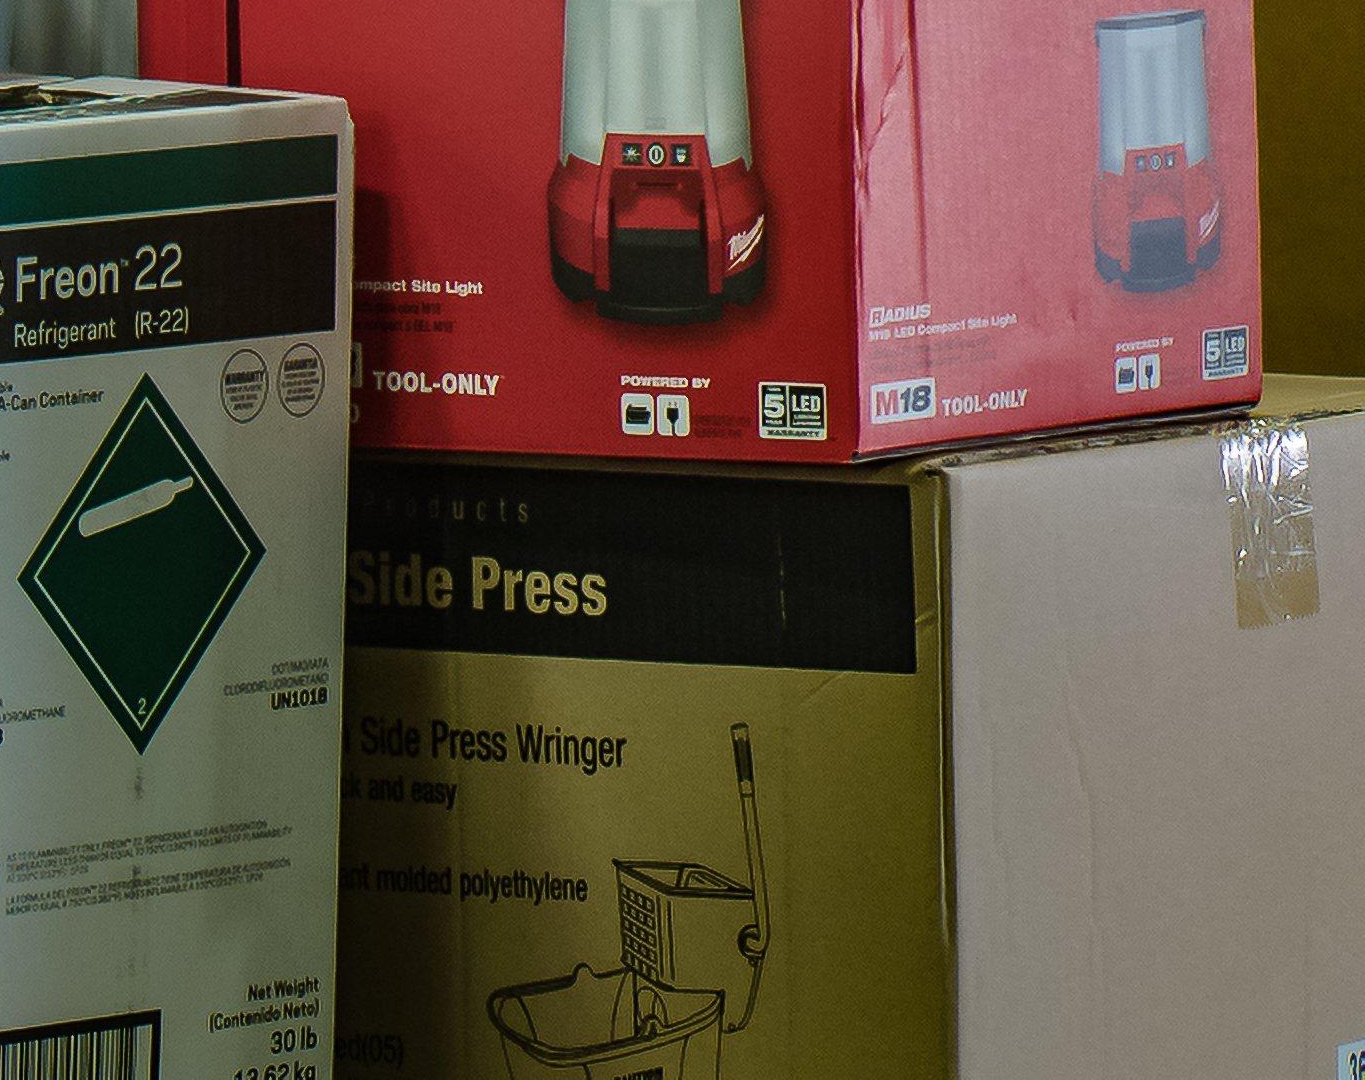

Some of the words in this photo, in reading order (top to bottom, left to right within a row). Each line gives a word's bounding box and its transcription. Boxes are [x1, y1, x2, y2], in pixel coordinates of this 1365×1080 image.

[13, 317, 117, 349] Refrigerant
[135, 307, 189, 338] (R-22)
[373, 371, 500, 396] TOOL-ONLY
[621, 375, 689, 389] POWERED
[691, 376, 711, 389] BY
[38, 388, 105, 410] Container
[764, 391, 785, 418] 5
[792, 394, 821, 413] LED
[875, 384, 932, 416] M18
[941, 388, 1028, 417] TOOL-ONLY
[349, 549, 453, 610] Side
[471, 556, 608, 617] Press
[138, 697, 147, 716] 2
[271, 686, 329, 711] UN1018
[360, 718, 420, 757] Side
[431, 719, 509, 764] Press
[514, 723, 628, 776] Wringer
[369, 776, 405, 803] and
[410, 783, 458, 812] easy
[270, 1028, 296, 1055] 30
[299, 1024, 319, 1051] lb
